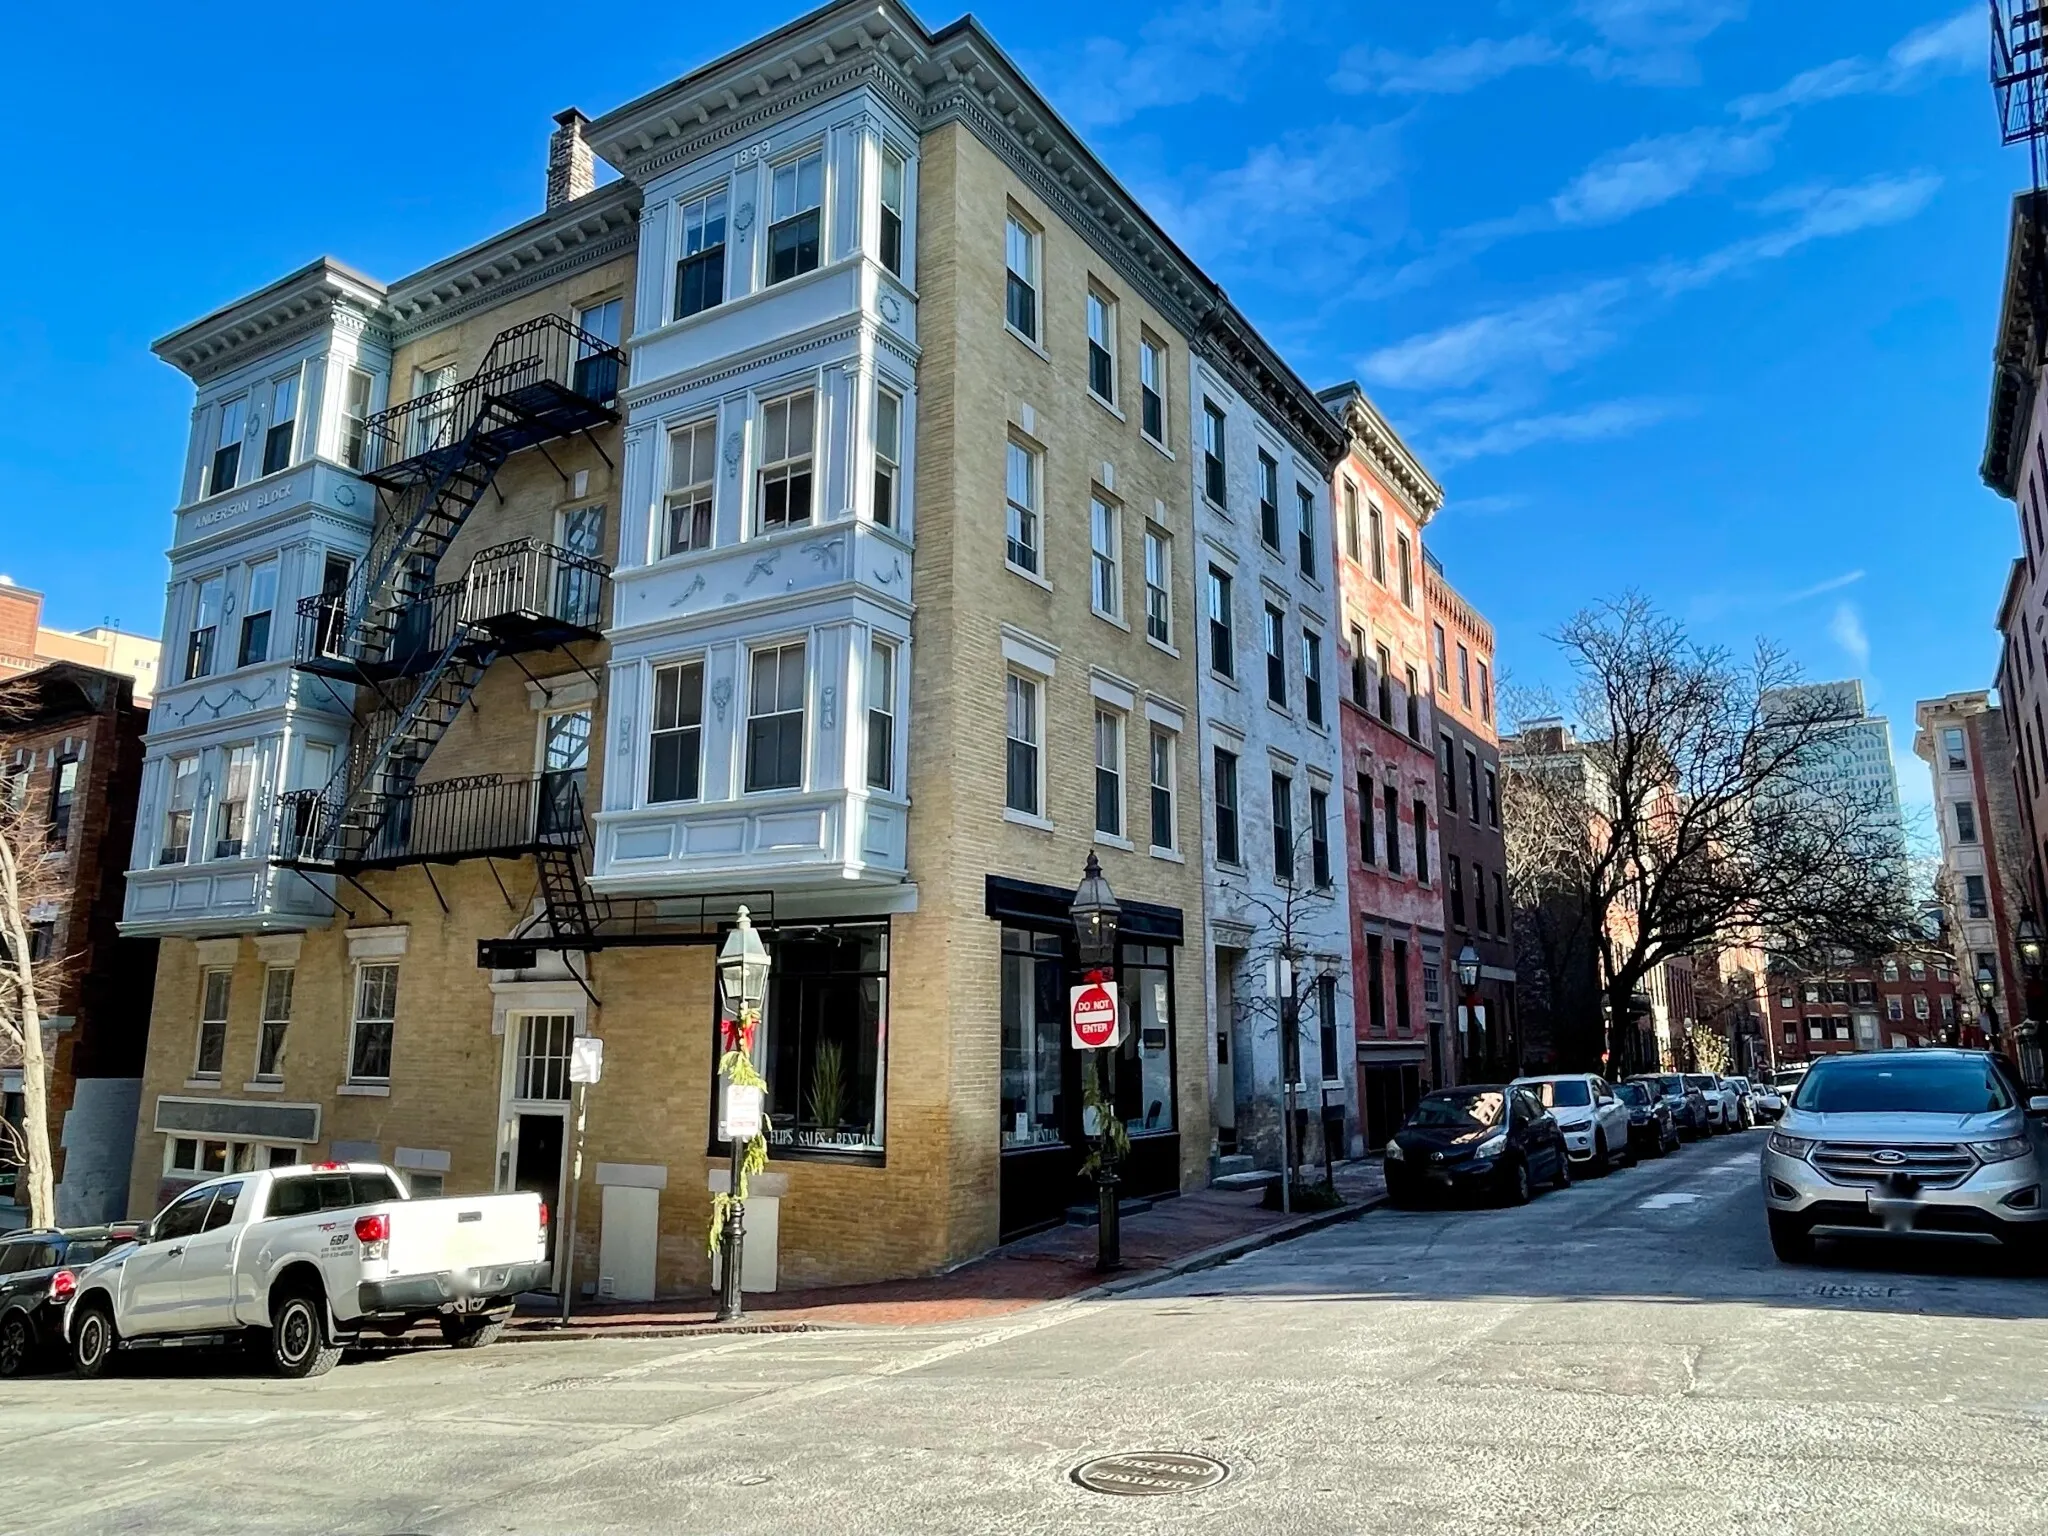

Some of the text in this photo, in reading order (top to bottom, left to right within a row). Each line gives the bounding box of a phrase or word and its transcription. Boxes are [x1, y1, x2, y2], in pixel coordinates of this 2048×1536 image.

[734, 140, 771, 168] 1899
[194, 483, 293, 530] ANDERSON BLOCK
[1078, 999, 1110, 1011] DO NOT
[1082, 1023, 1108, 1034] ENTER
[798, 1131, 826, 1147] SALES
